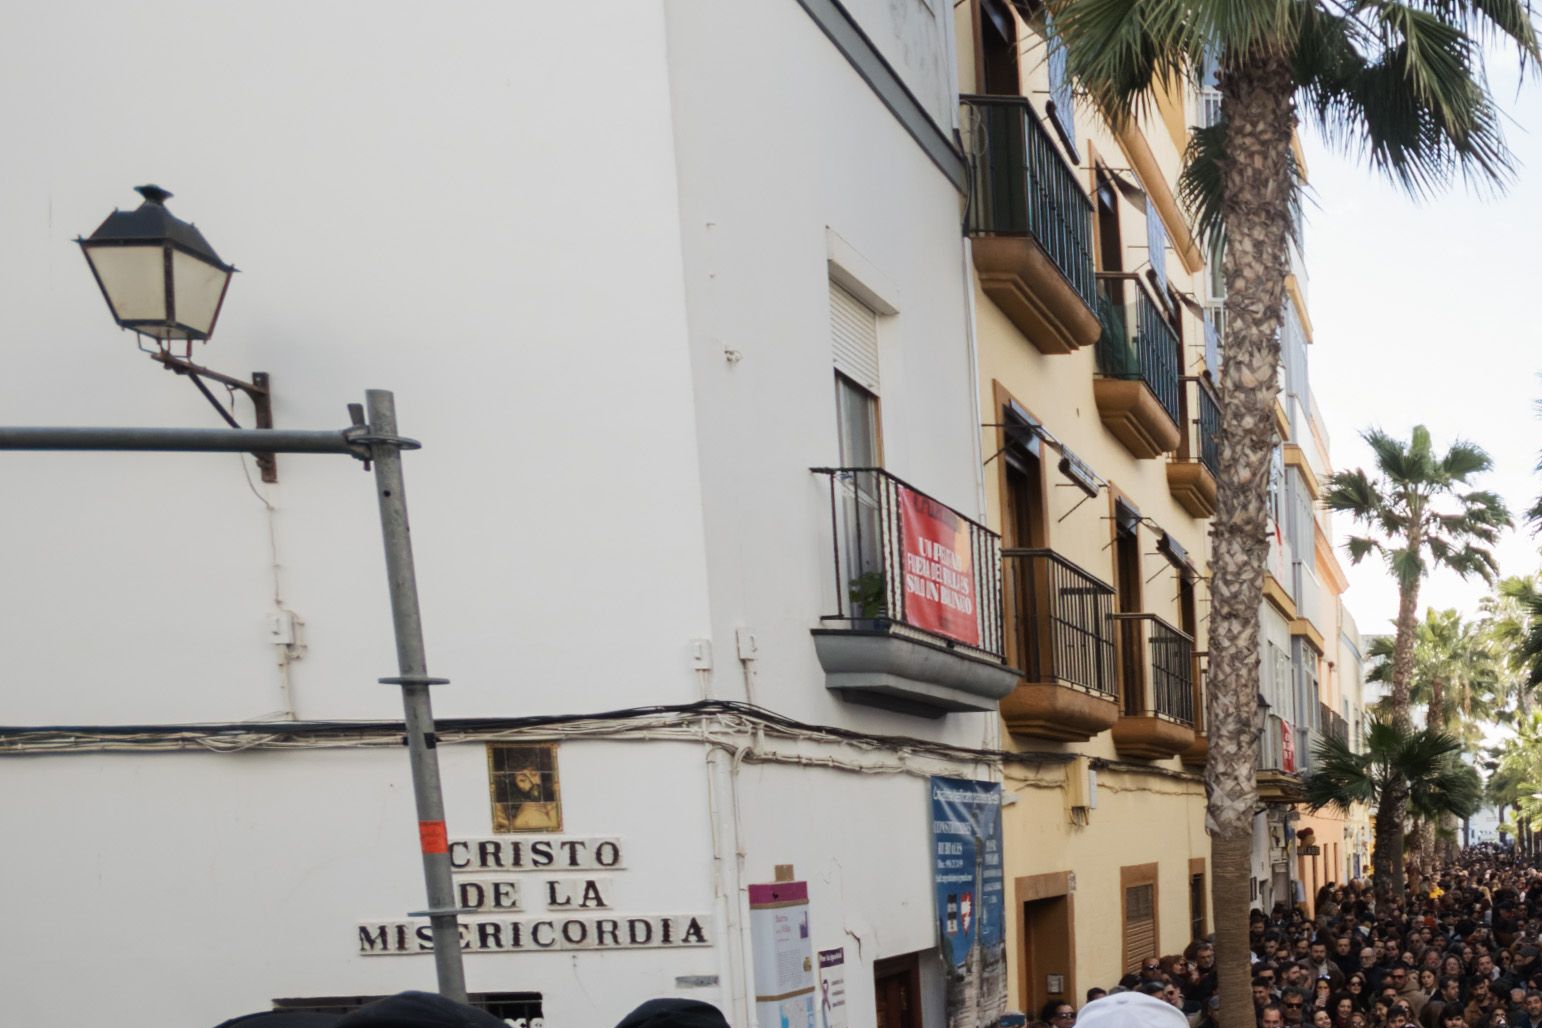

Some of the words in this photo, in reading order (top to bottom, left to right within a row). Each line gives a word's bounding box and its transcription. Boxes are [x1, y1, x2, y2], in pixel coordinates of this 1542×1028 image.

[449, 840, 621, 869] CRISTO
[459, 881, 518, 910] DE
[547, 879, 609, 908] LA
[358, 916, 708, 951] MISERICORDIA
